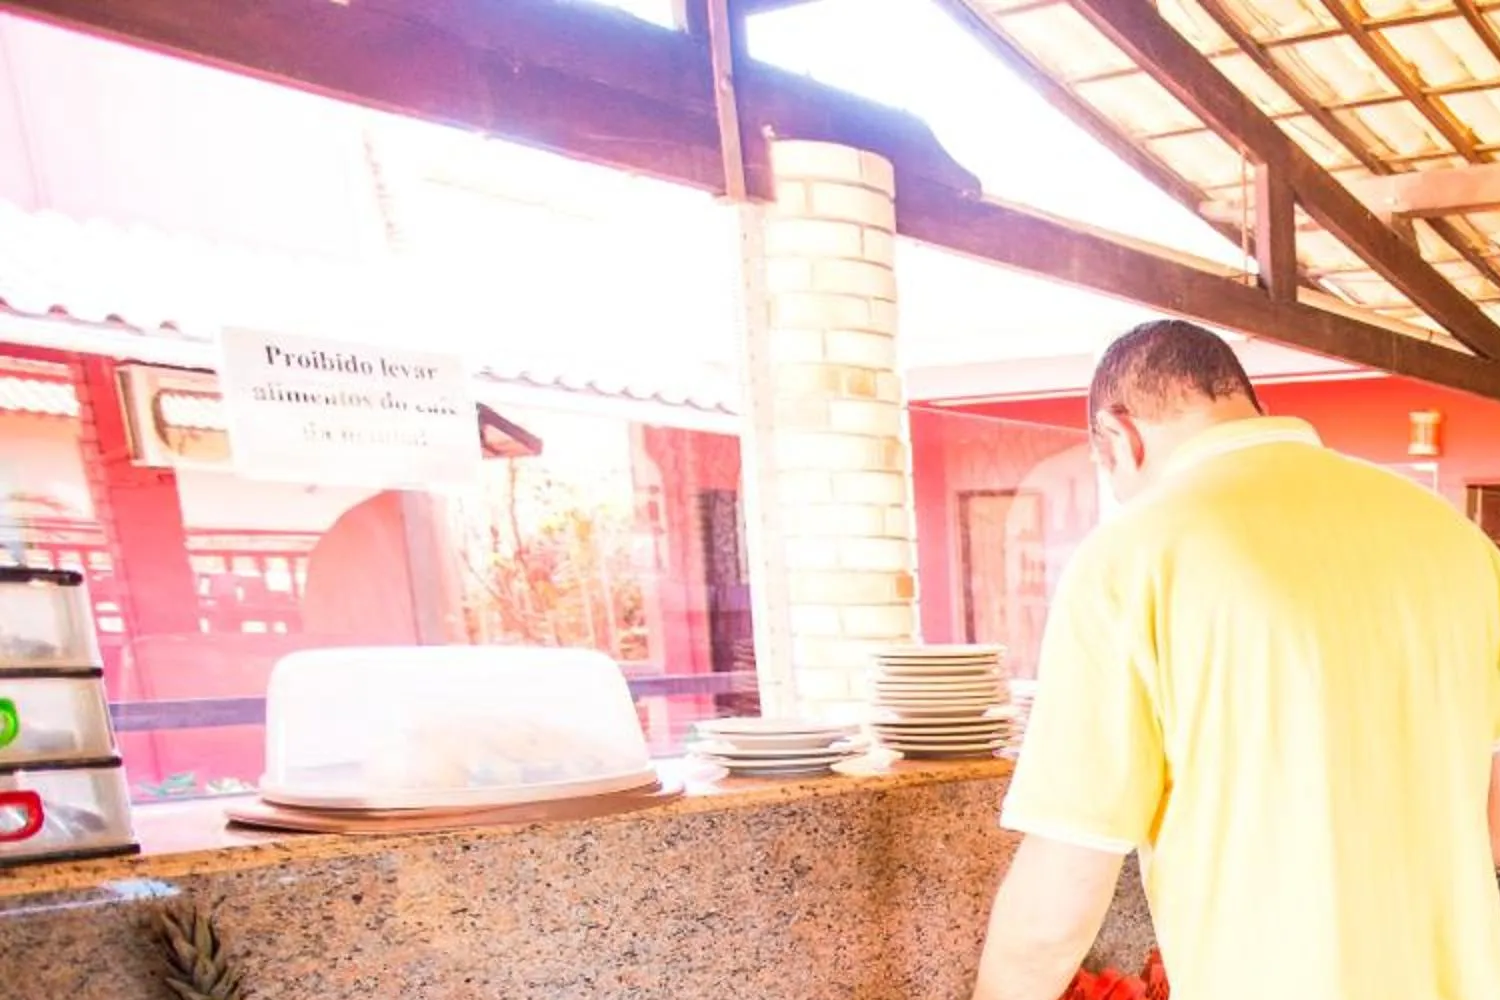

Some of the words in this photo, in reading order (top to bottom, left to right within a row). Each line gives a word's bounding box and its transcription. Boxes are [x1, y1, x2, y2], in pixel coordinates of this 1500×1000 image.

[264, 343, 374, 376] Proibido
[379, 355, 439, 381] levar
[251, 381, 372, 407] alimentos
[379, 390, 408, 412] do
